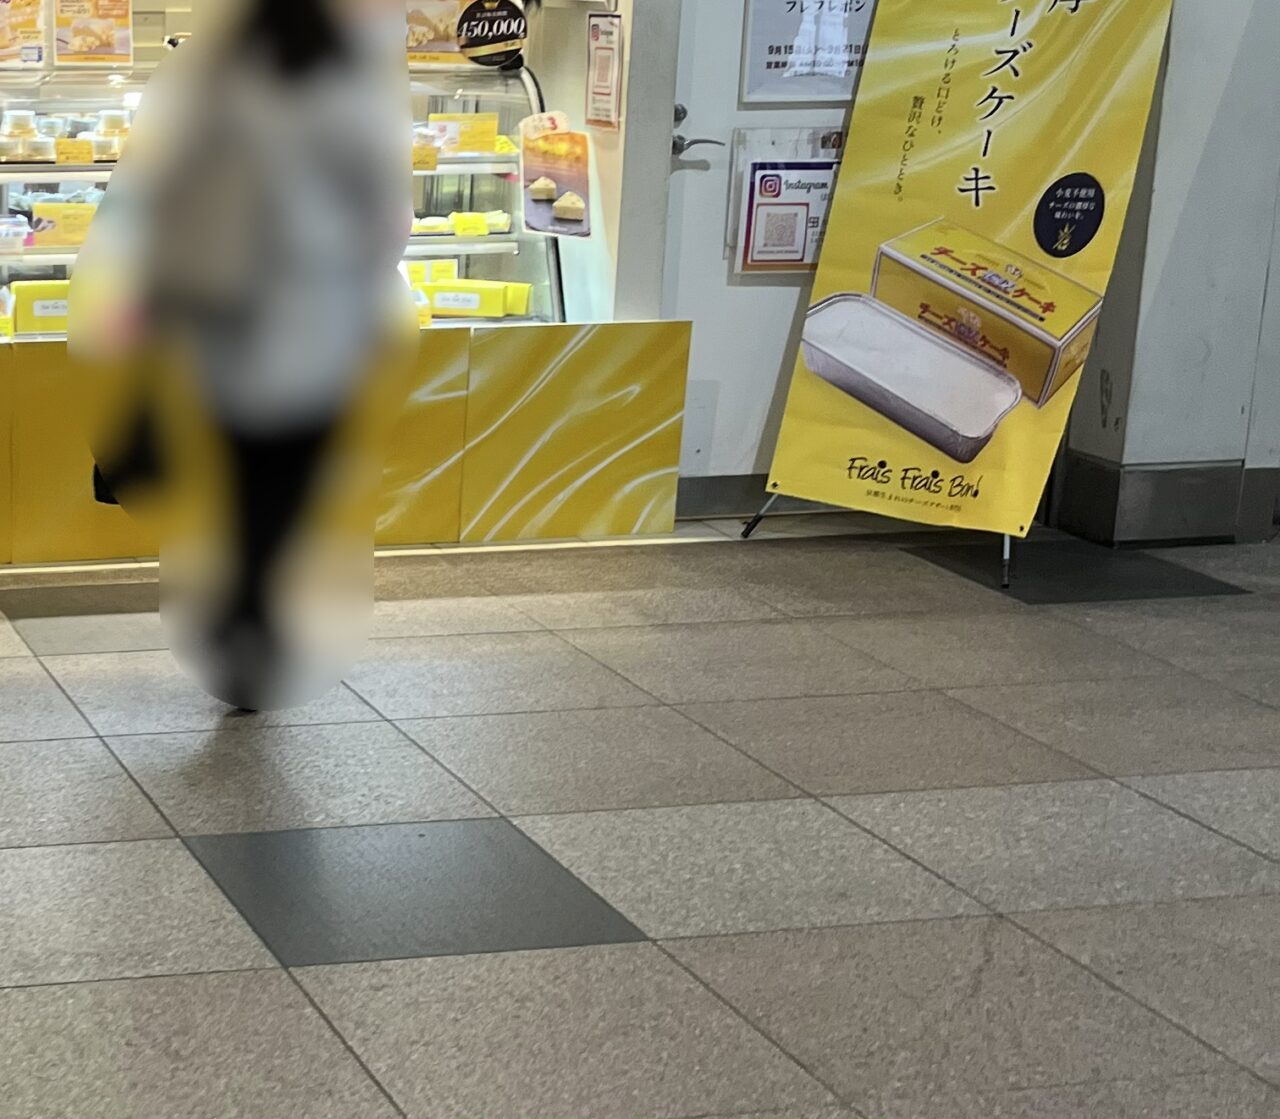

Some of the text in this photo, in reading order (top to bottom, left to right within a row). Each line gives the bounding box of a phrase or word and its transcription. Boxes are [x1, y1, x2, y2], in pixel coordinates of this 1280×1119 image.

[784, 179, 828, 194] Instagram
[847, 456, 984, 498] Frais Frais Bon!
